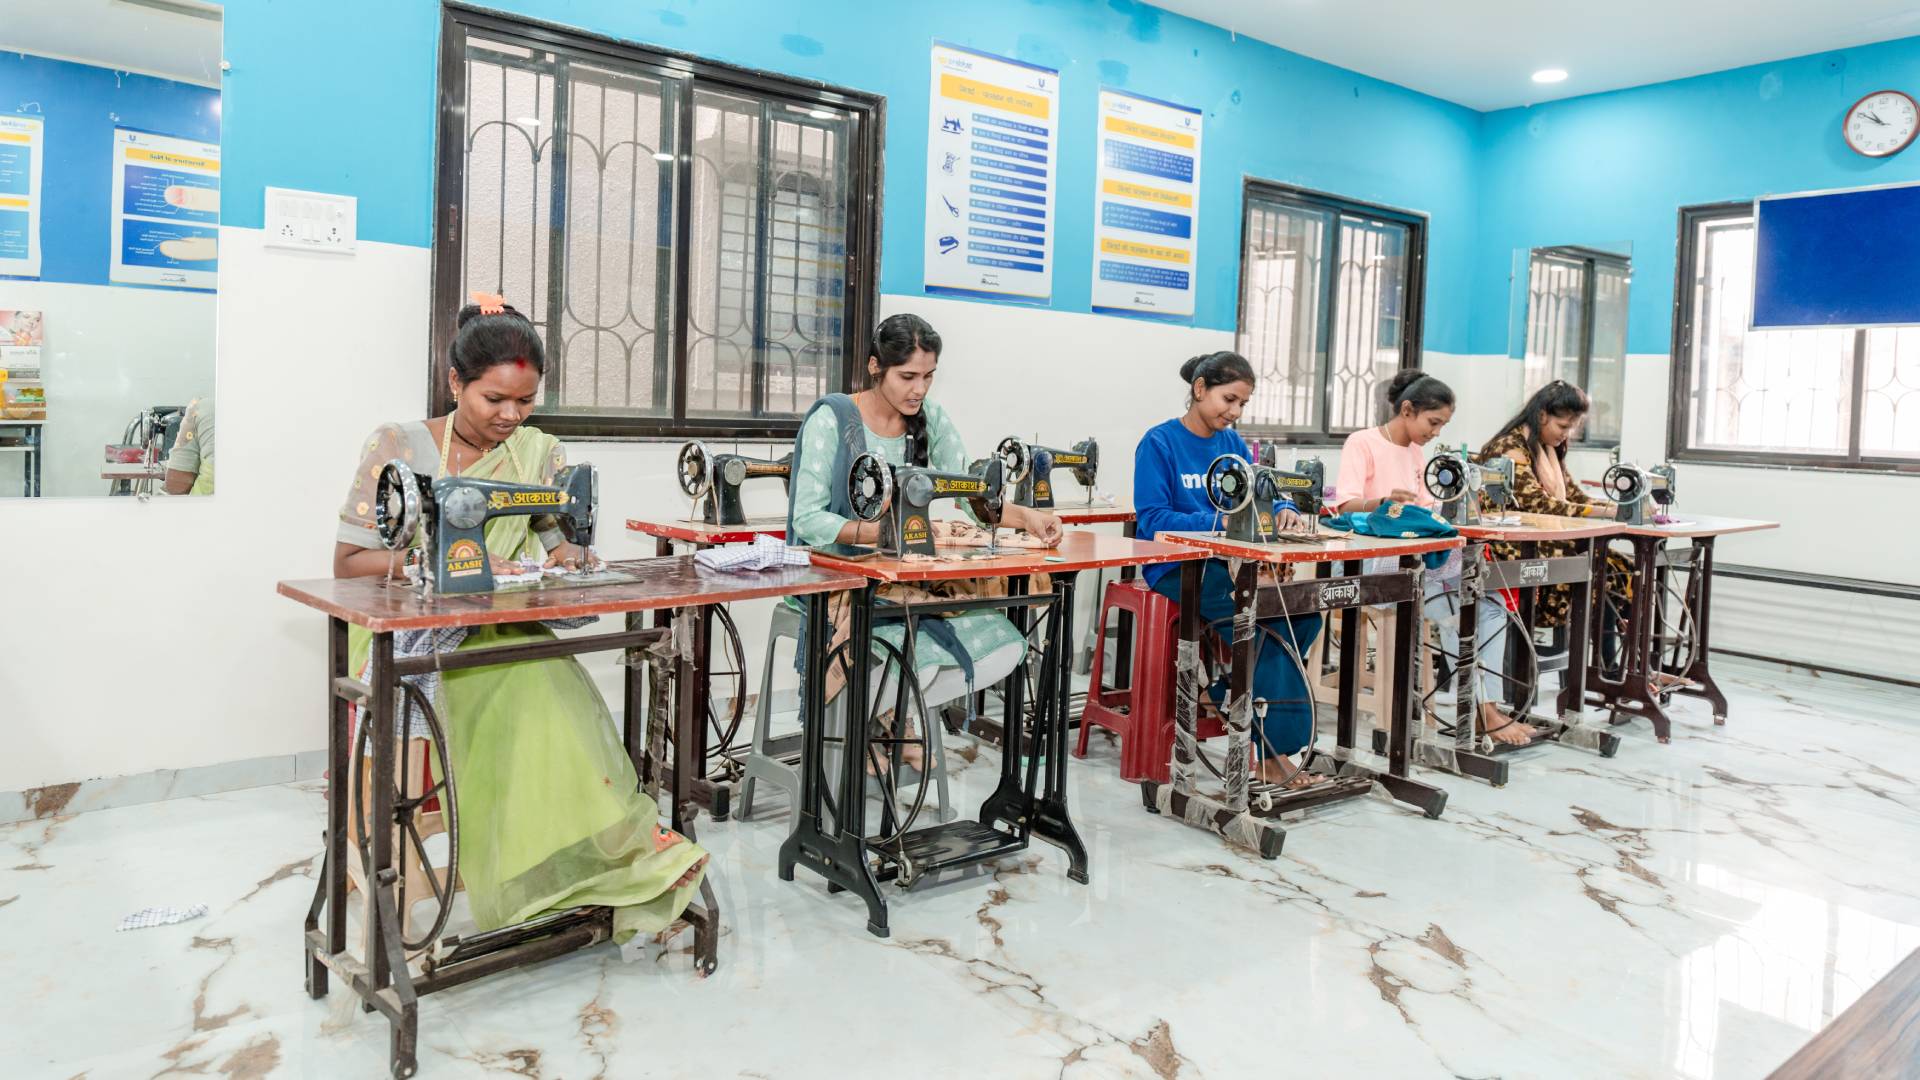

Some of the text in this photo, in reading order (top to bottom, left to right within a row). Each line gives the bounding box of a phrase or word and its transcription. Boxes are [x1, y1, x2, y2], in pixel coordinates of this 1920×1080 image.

[950, 480, 978, 490] आकाश
[513, 492, 556, 504] आकाश
[904, 532, 928, 540] AKASH
[447, 560, 483, 571] AKASH
[1523, 565, 1546, 578] आकाश
[1322, 584, 1357, 601] आकाश
